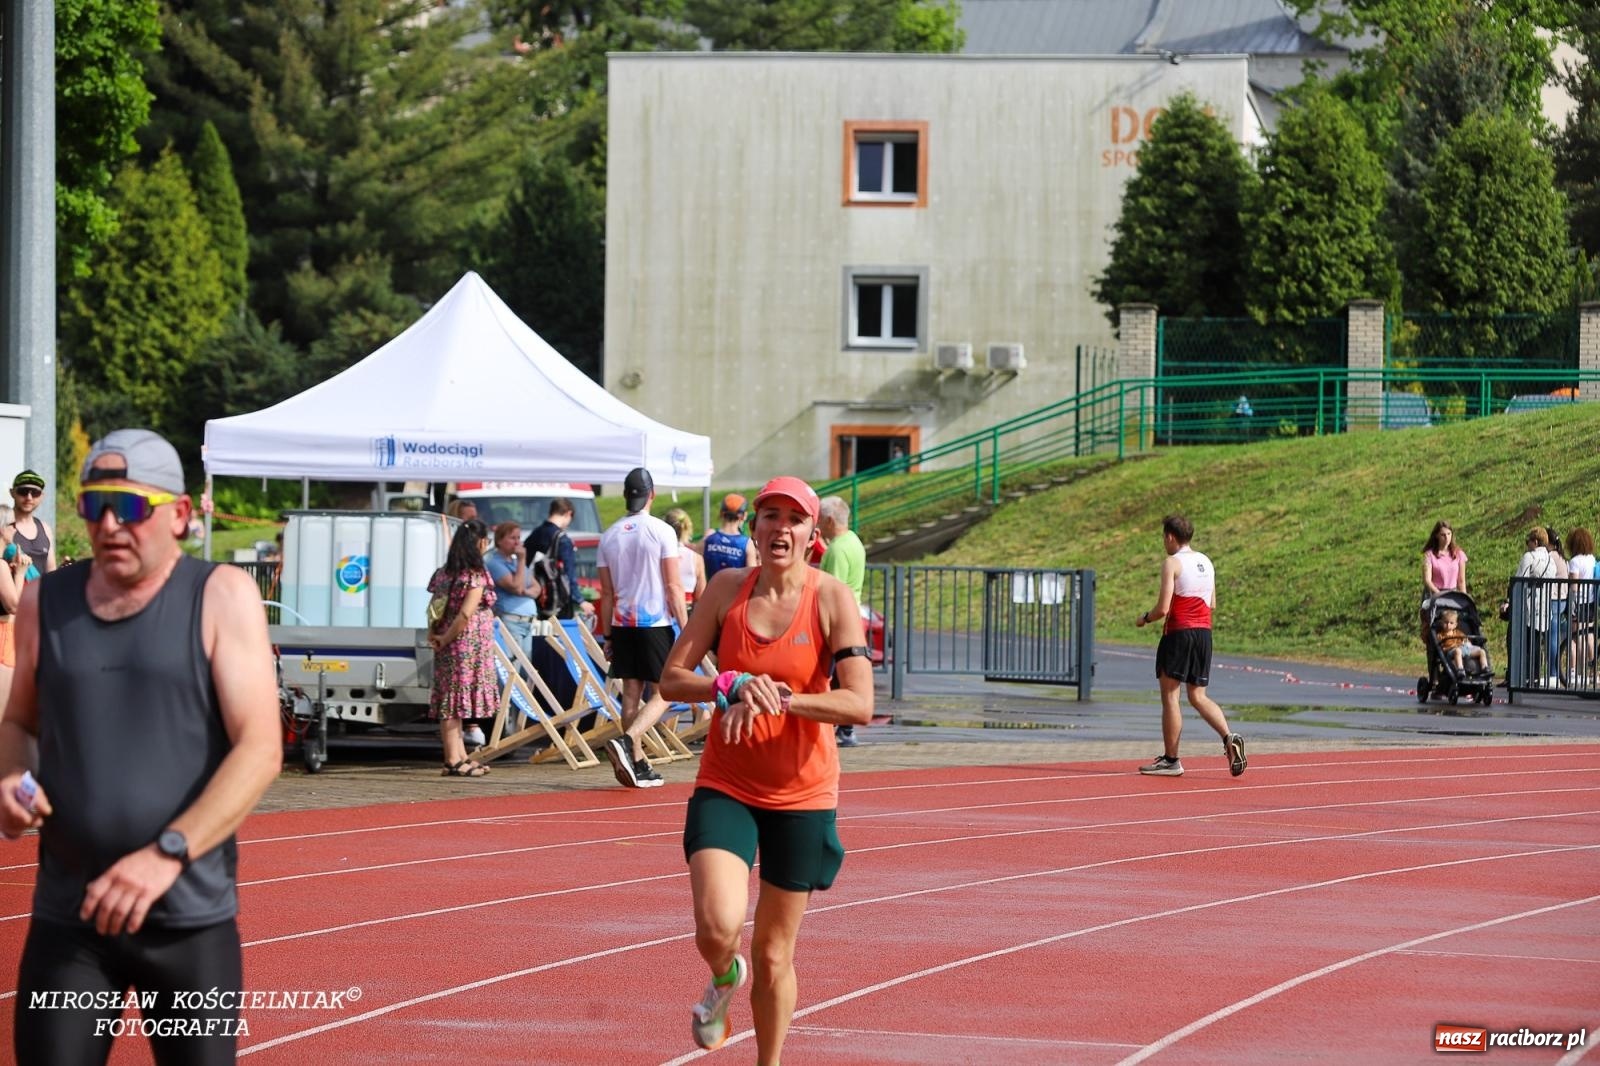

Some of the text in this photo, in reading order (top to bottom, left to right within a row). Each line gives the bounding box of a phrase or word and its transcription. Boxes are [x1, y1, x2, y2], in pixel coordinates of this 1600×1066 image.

[1102, 149, 1141, 167] SPO
[402, 441, 484, 457] Wodociągi
[403, 456, 484, 469] Raciborskie
